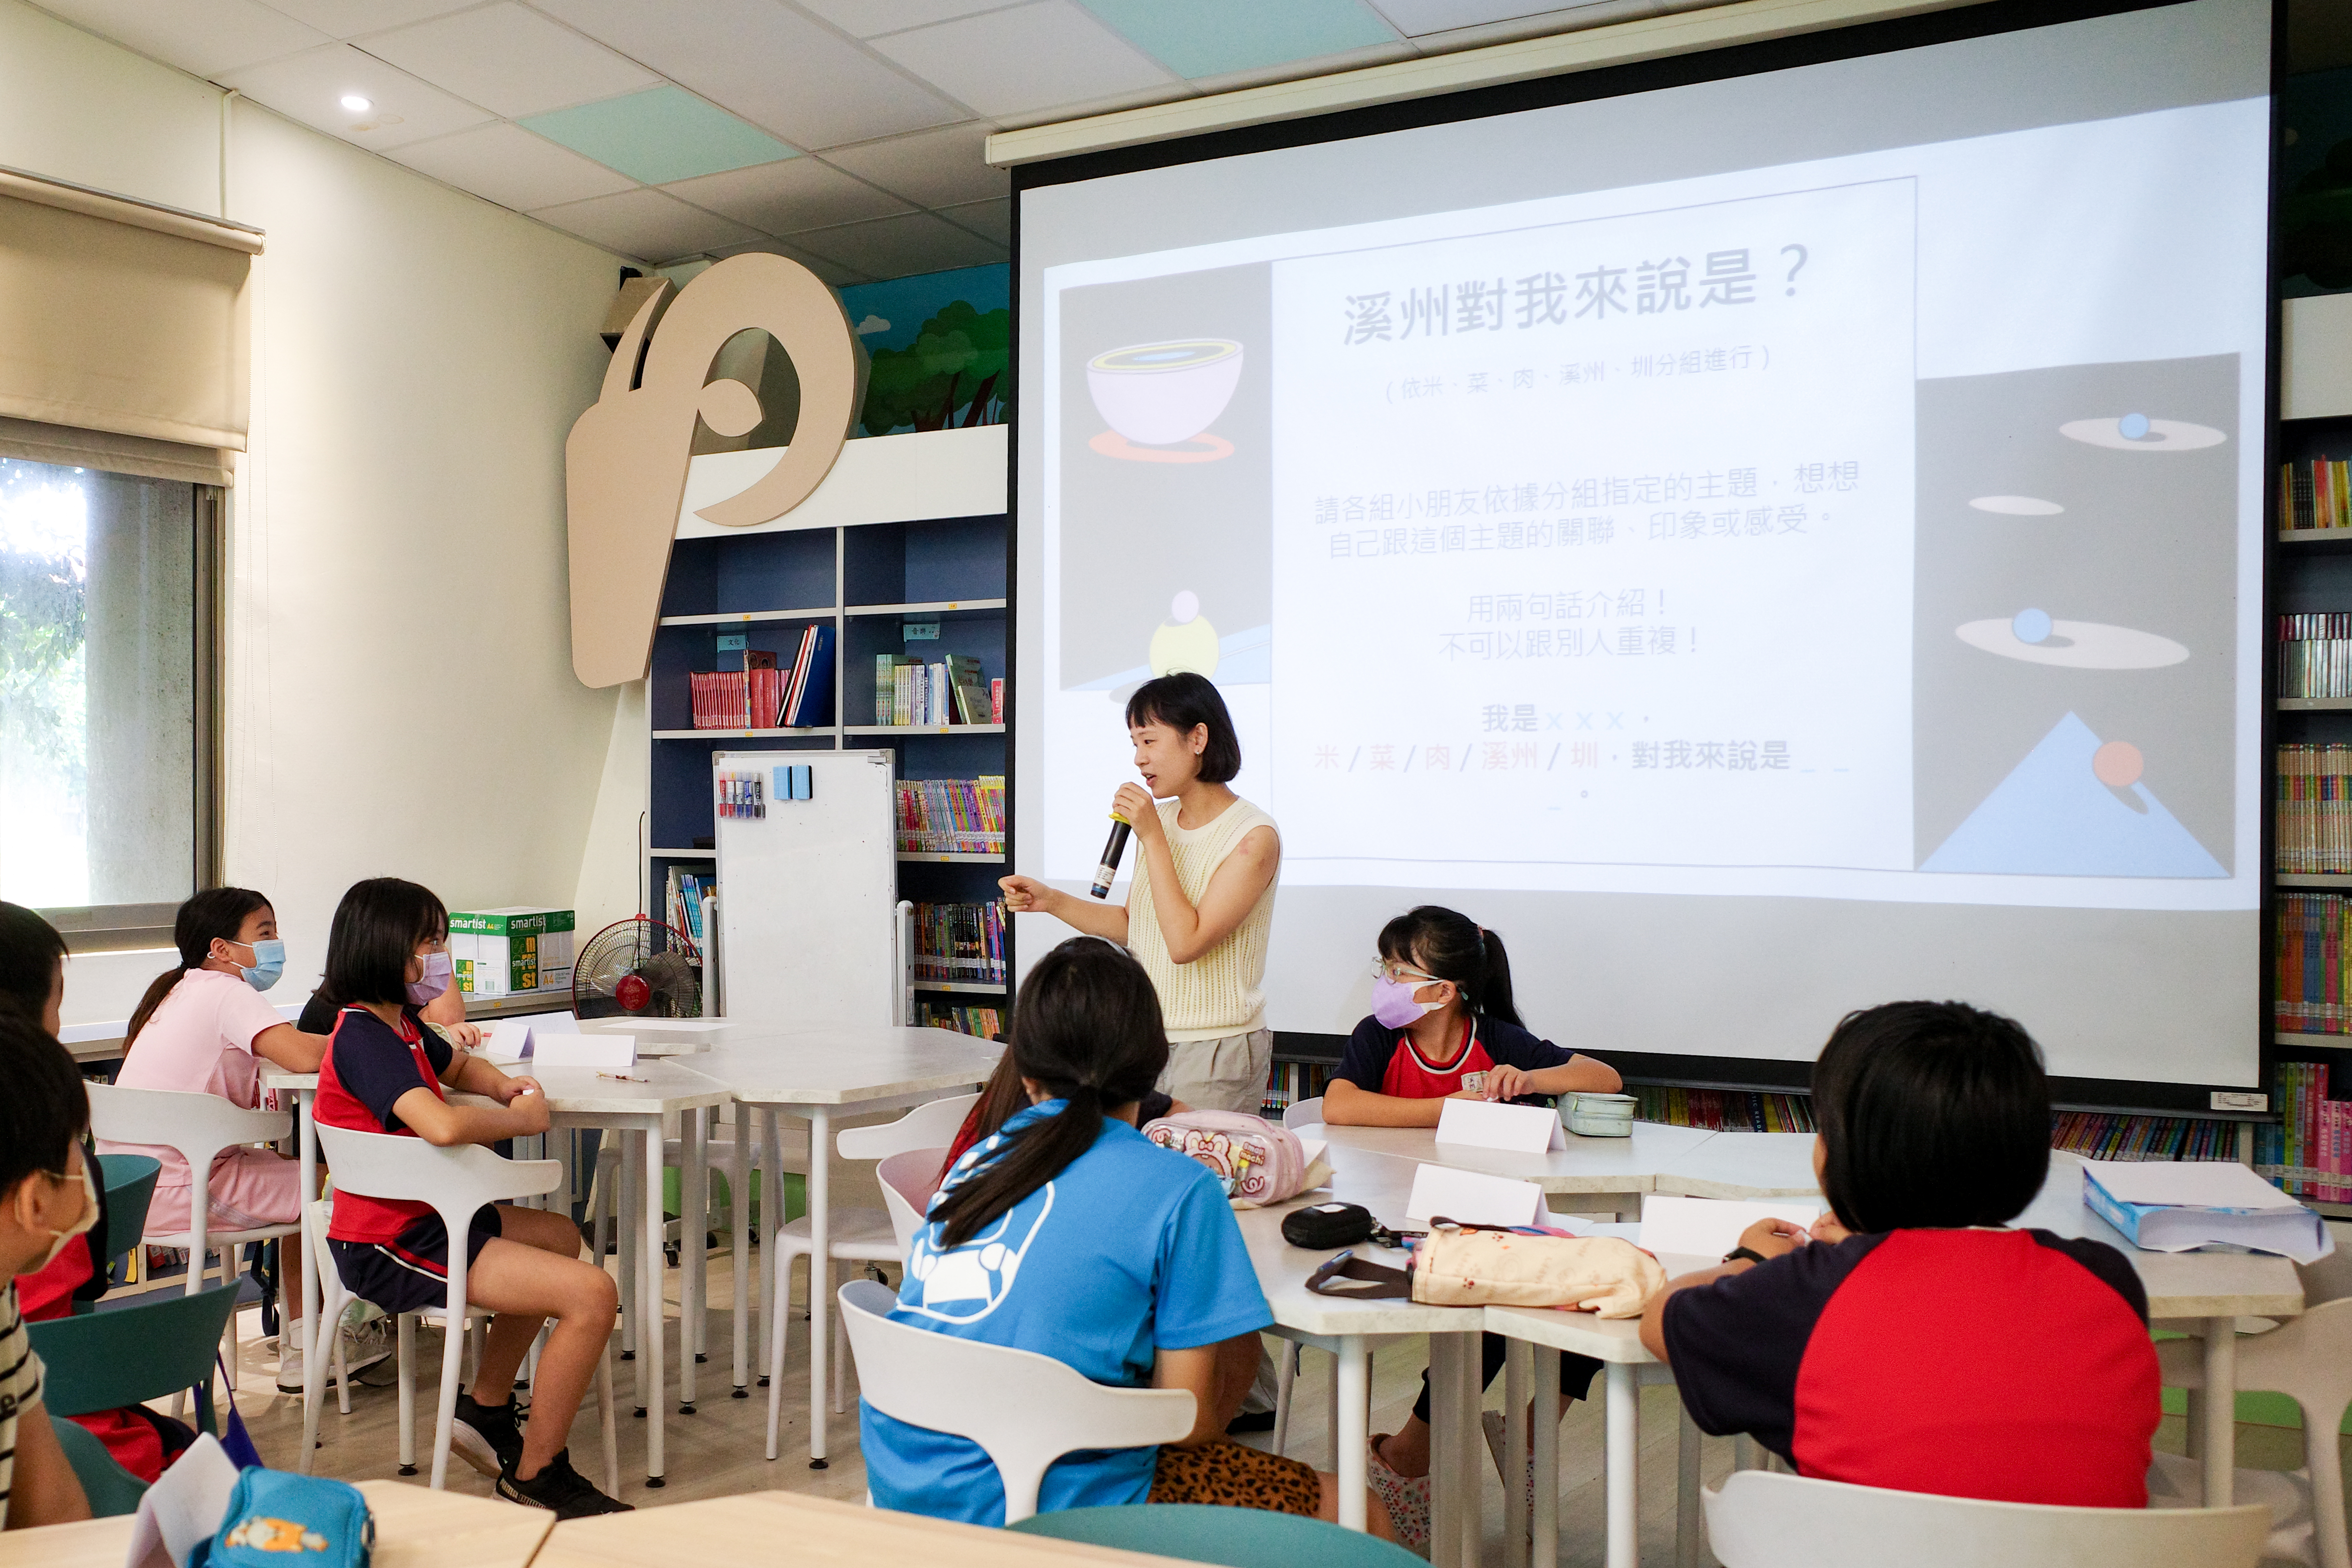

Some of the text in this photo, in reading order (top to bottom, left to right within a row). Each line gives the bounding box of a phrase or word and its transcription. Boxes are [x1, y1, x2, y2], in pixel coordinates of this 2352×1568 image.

[1343, 243, 1810, 346] 溪州對我來說是？
[450, 919, 486, 929] smartist
[511, 915, 546, 929] smartist
[512, 958, 536, 967] smartist
[543, 974, 554, 986] A4
